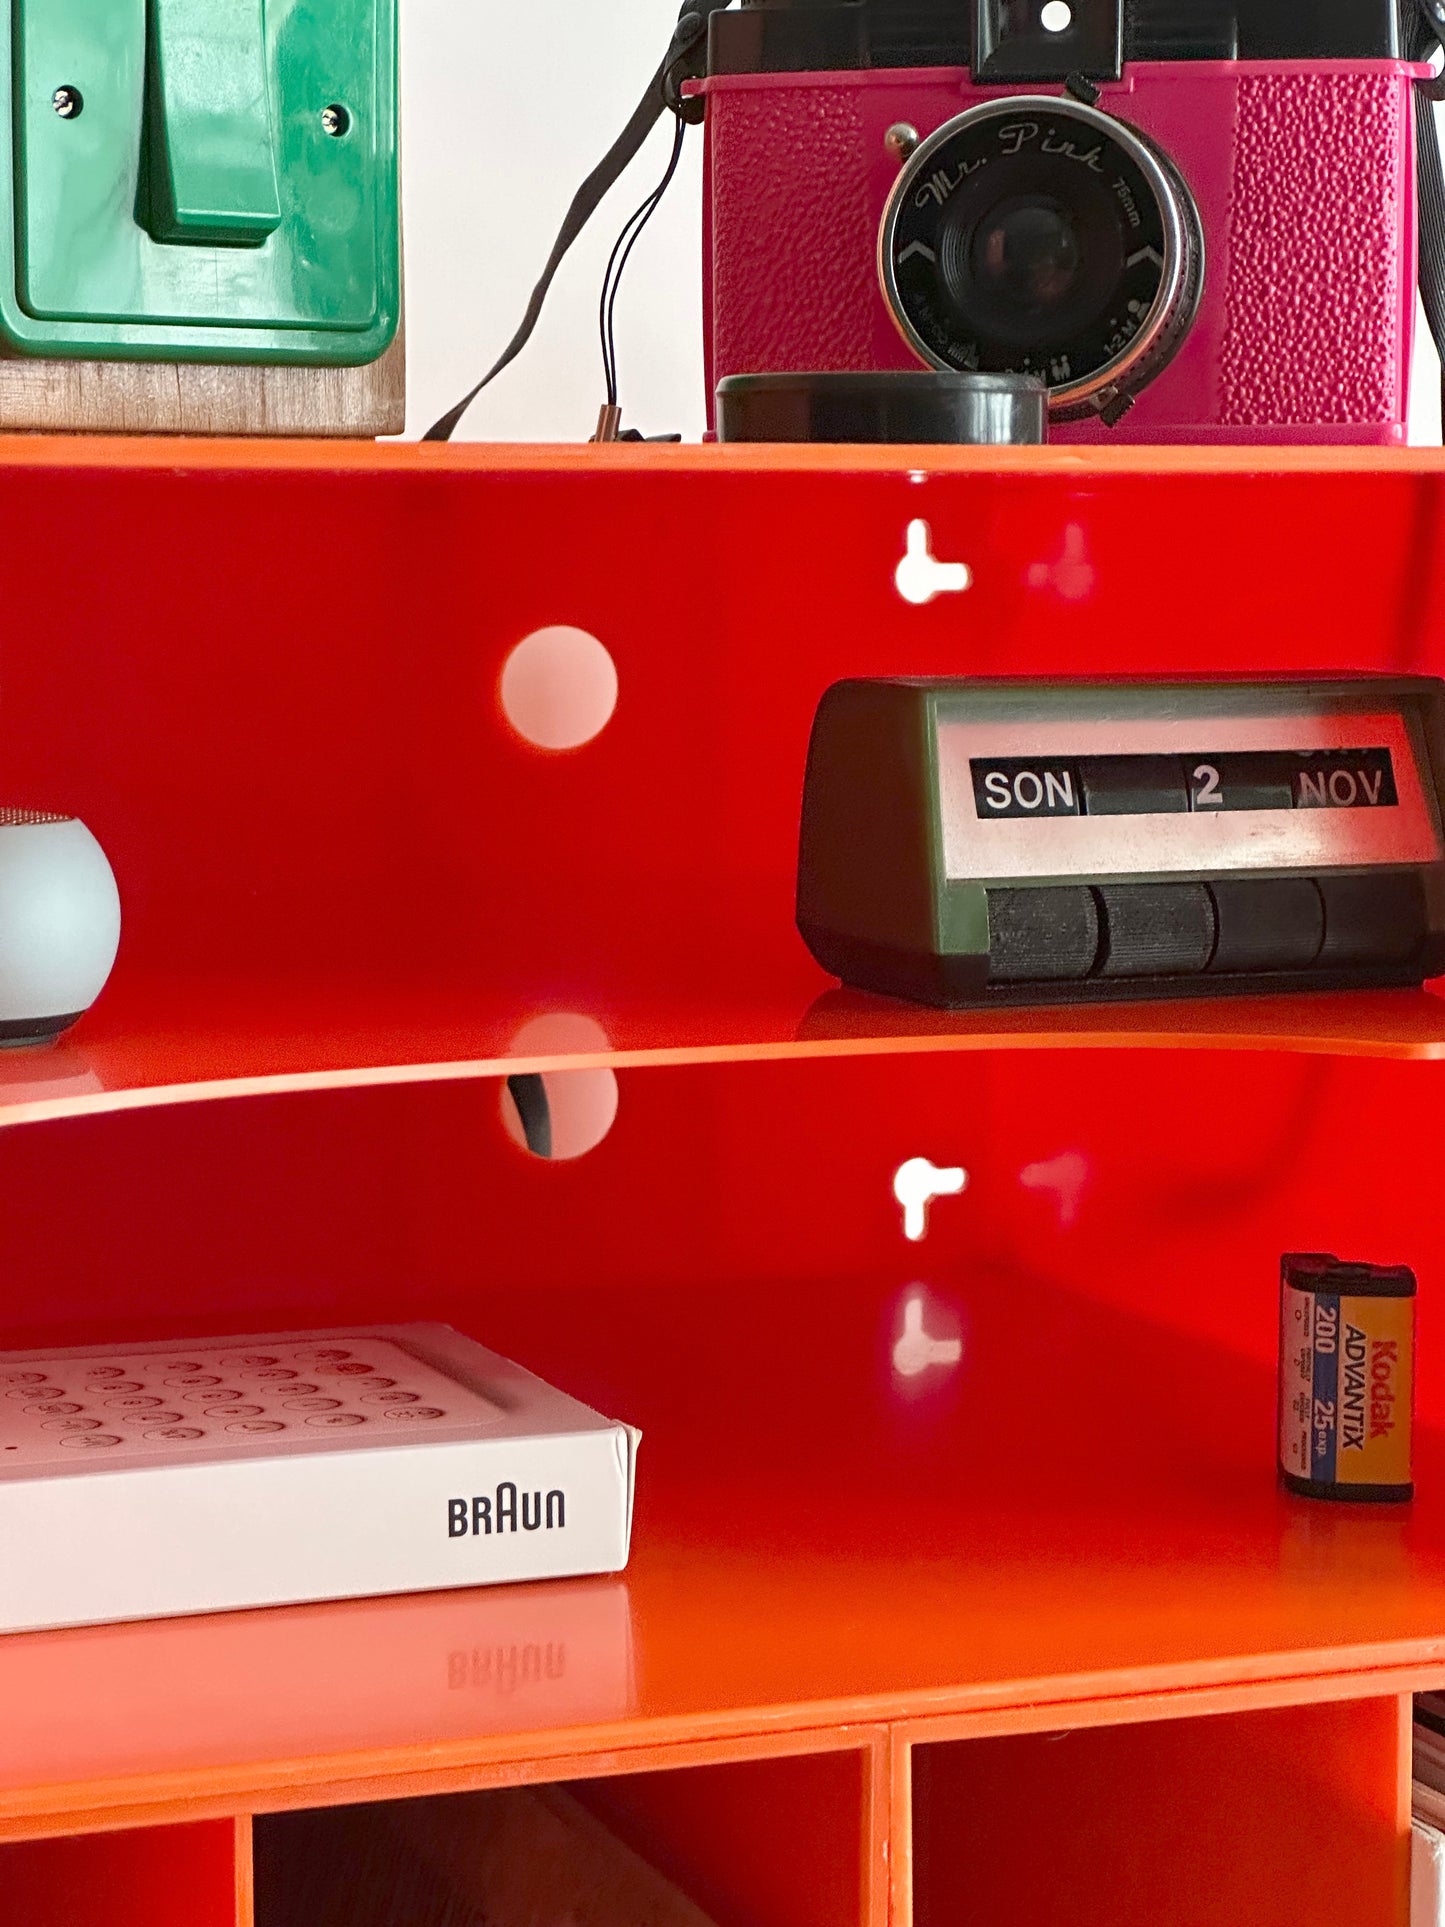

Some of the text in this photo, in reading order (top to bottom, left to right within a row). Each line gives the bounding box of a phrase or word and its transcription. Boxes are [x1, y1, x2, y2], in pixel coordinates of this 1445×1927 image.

[915, 122, 1104, 208] Mr. Pink
[985, 764, 1382, 809] SON 2 NOV
[1315, 1305, 1337, 1354] 200
[1370, 1340, 1398, 1440] Kodak
[448, 1482, 565, 1538] BRAUN
